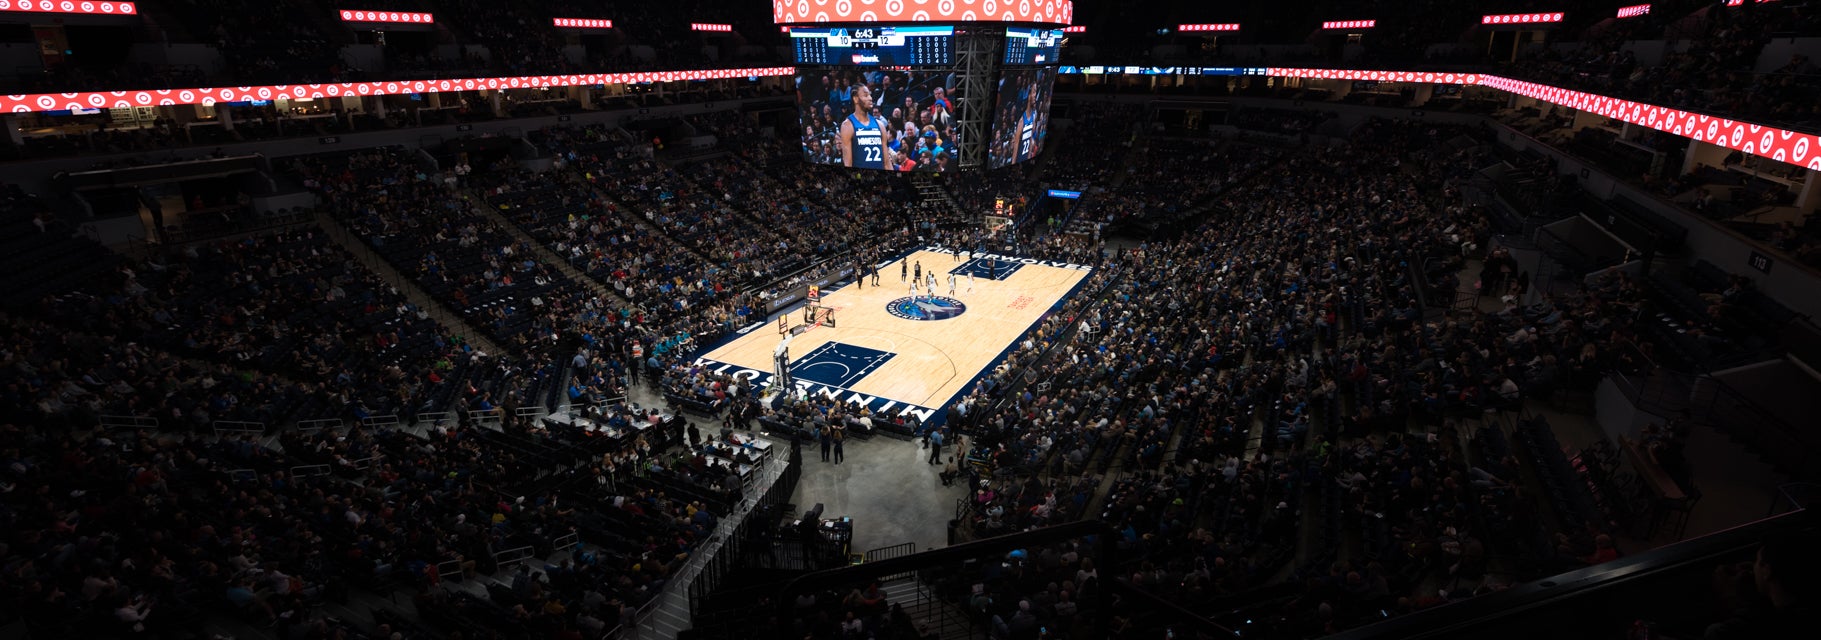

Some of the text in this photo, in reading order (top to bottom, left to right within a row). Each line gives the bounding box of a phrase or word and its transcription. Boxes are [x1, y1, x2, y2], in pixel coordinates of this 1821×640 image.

[855, 28, 873, 38] 6:43
[840, 36, 848, 44] 10
[880, 36, 888, 44] 12
[1022, 140, 1030, 155] 22
[864, 146, 882, 162] 22
[925, 246, 1094, 272] TIMBERWOLVES
